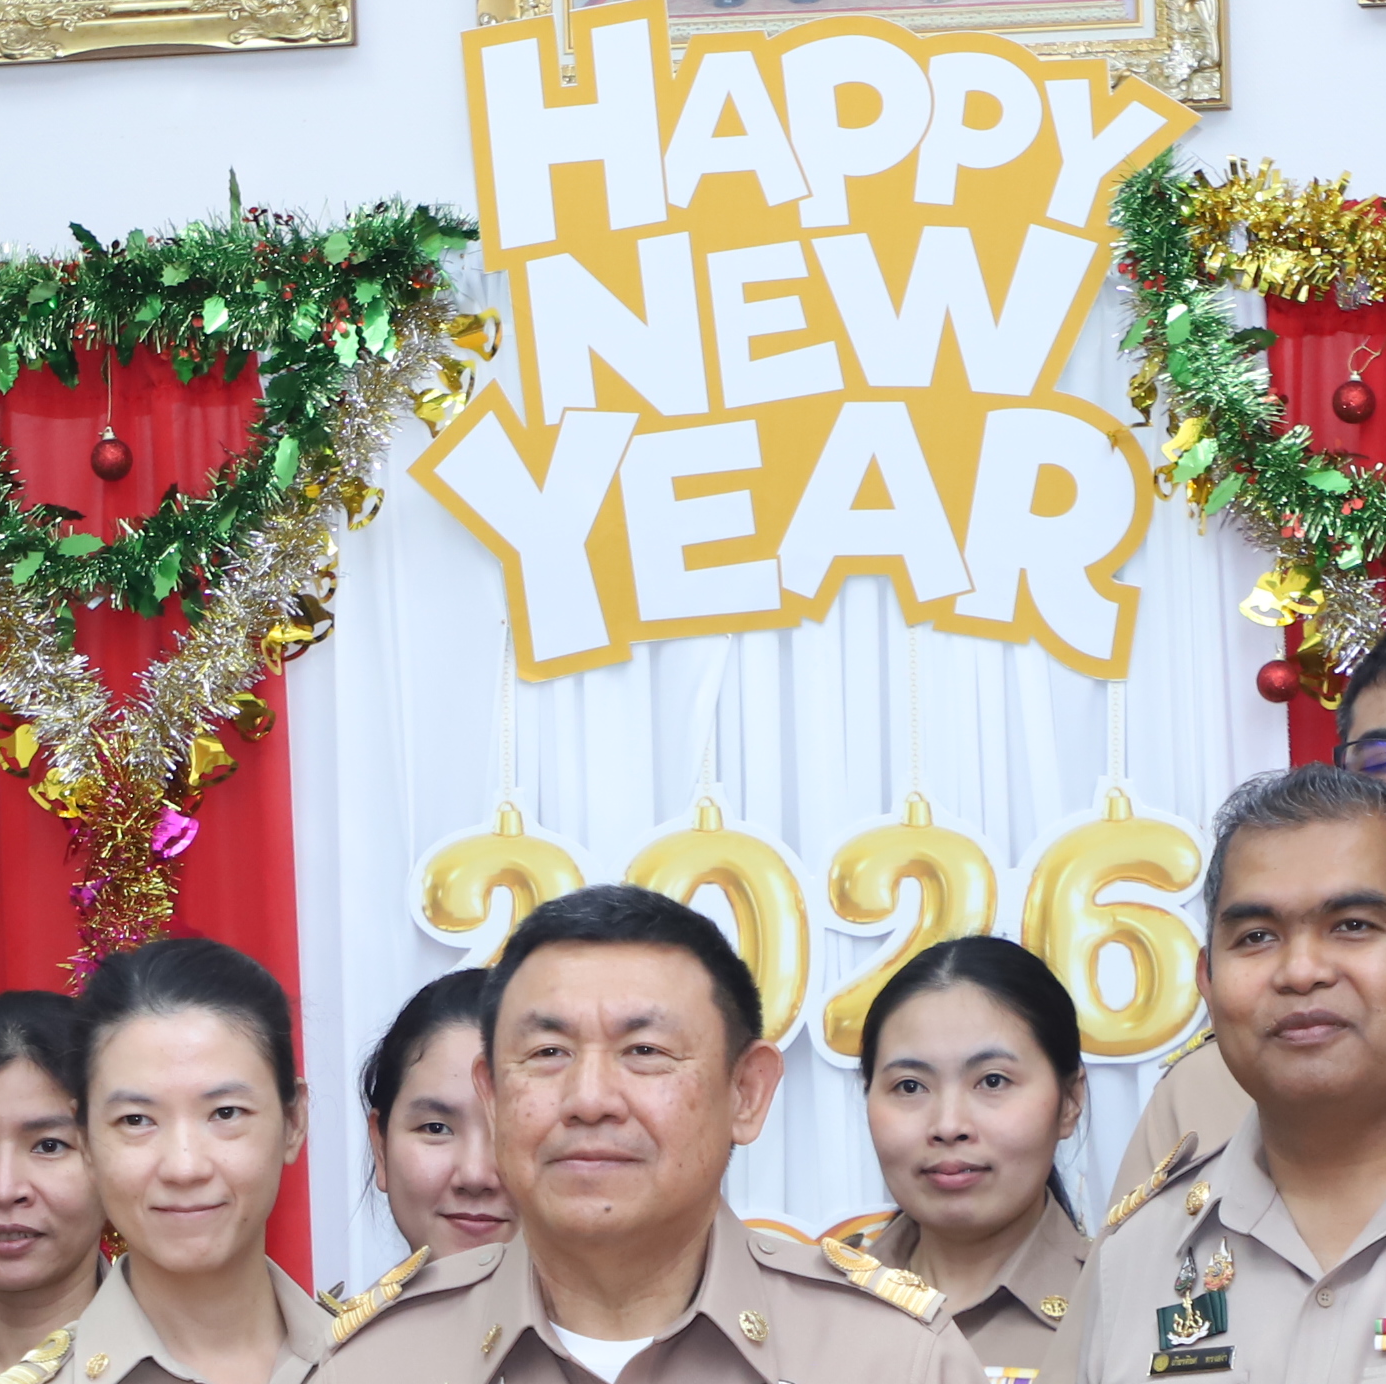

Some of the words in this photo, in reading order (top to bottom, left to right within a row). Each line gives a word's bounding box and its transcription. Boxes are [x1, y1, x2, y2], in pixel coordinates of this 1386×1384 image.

[480, 18, 1169, 251] HAPPY
[525, 224, 1099, 426] NEW
[433, 402, 1137, 664] YEAR
[420, 814, 1205, 1058] 2026
